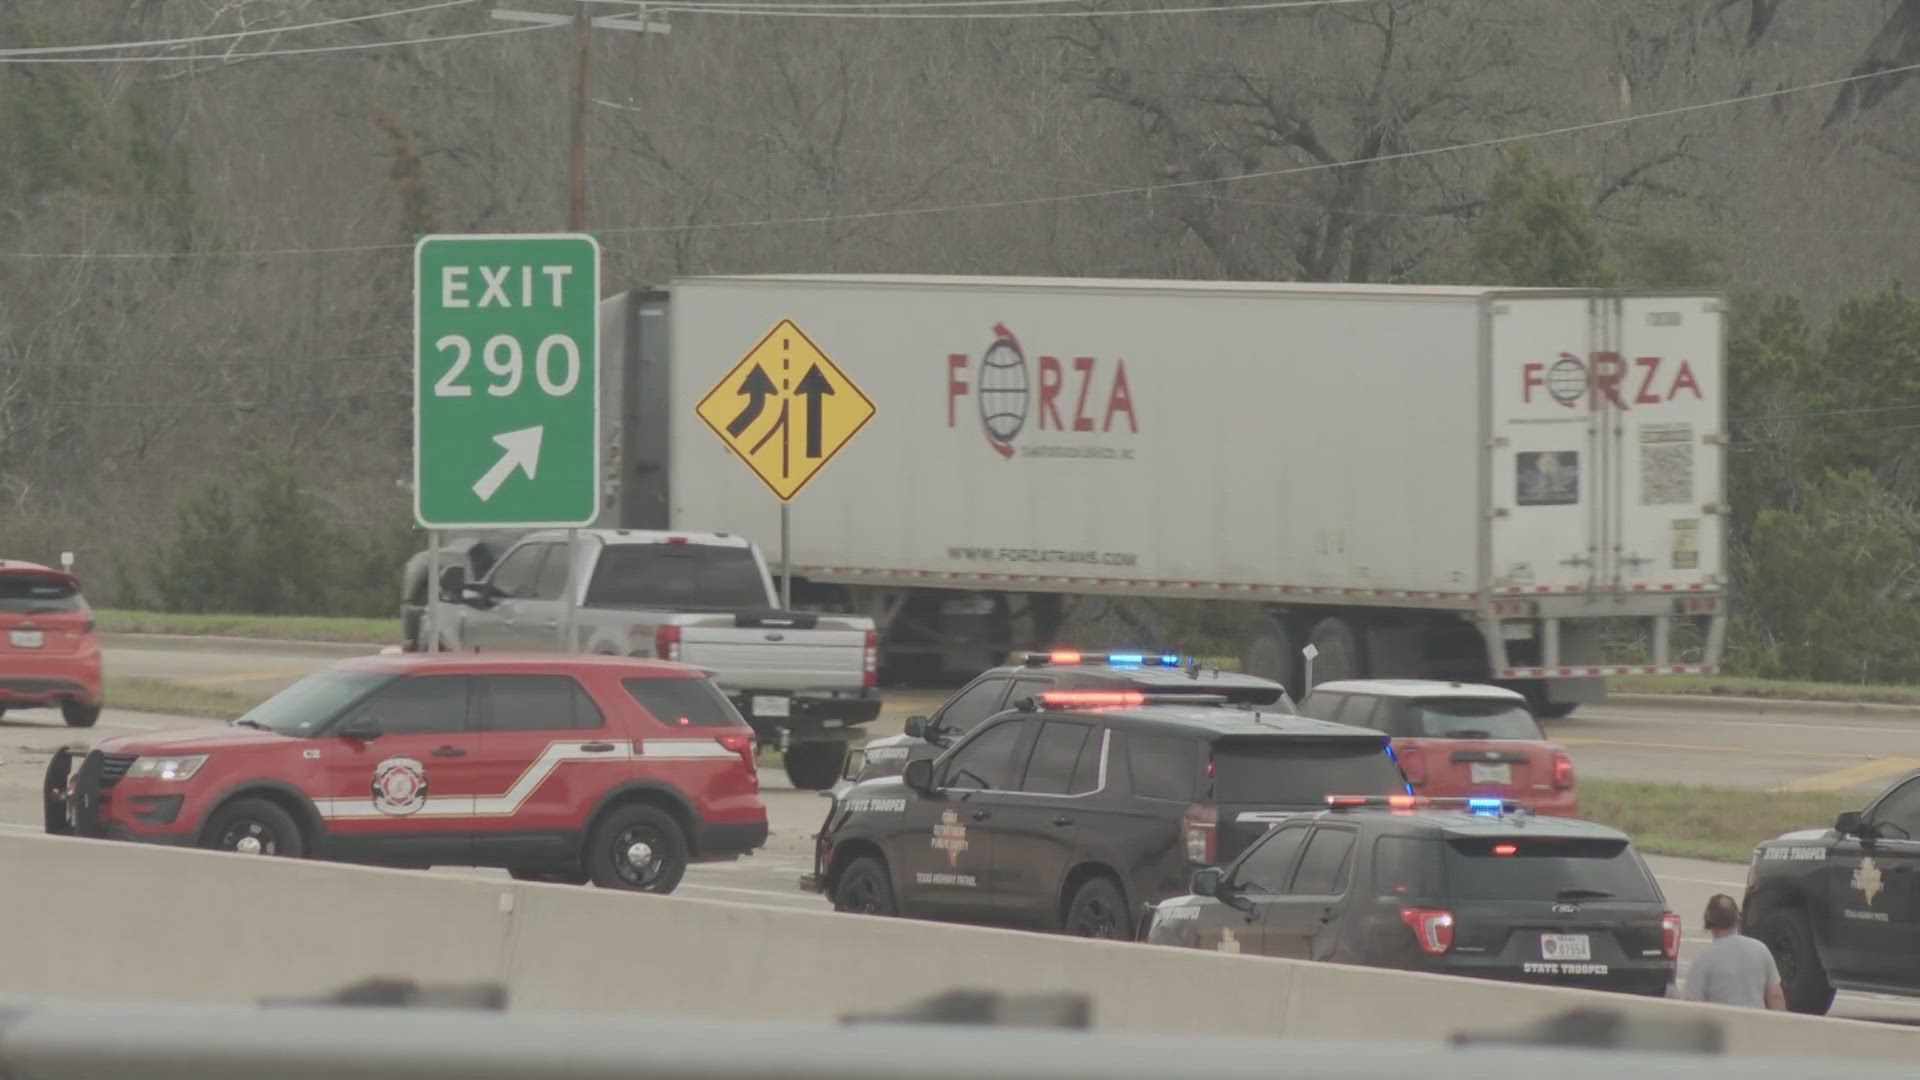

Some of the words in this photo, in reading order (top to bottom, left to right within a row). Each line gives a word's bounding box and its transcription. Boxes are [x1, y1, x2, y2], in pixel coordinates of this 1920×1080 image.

[442, 265, 573, 308] EXIT
[434, 334, 581, 397] 290
[1522, 350, 1703, 411] FORZA
[947, 337, 1140, 443] FORZA
[844, 799, 870, 812] STATE
[870, 799, 907, 812] TROOPER
[1764, 847, 1789, 860] STATE
[1789, 847, 1827, 860] TROOPER
[1523, 962, 1558, 974] STATE
[1560, 963, 1608, 975] TROOPER
